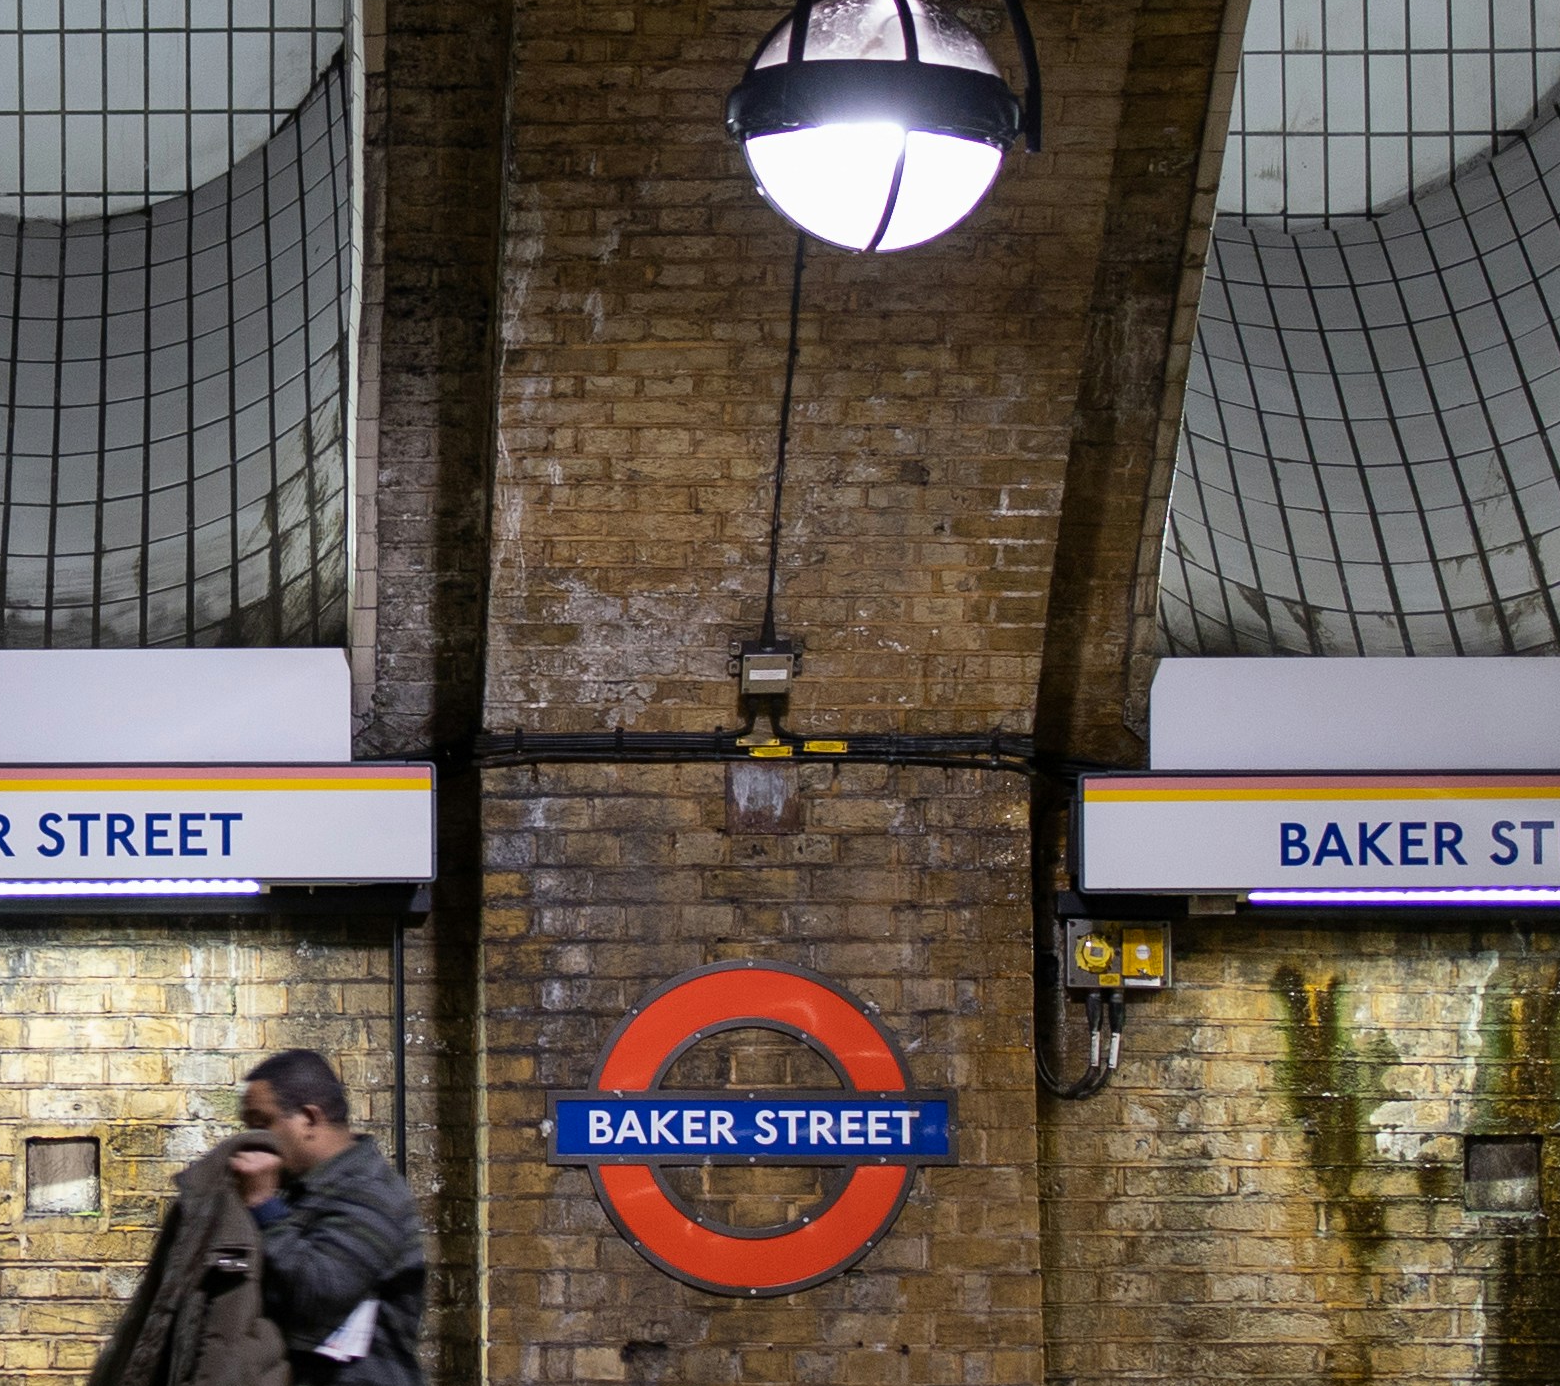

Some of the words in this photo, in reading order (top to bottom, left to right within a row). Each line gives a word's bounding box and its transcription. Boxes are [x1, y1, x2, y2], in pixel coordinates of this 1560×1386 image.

[37, 813, 242, 857] STREET
[1281, 822, 1467, 866] BAKER
[589, 1110, 735, 1144] BAKER
[754, 1110, 919, 1144] STREET
